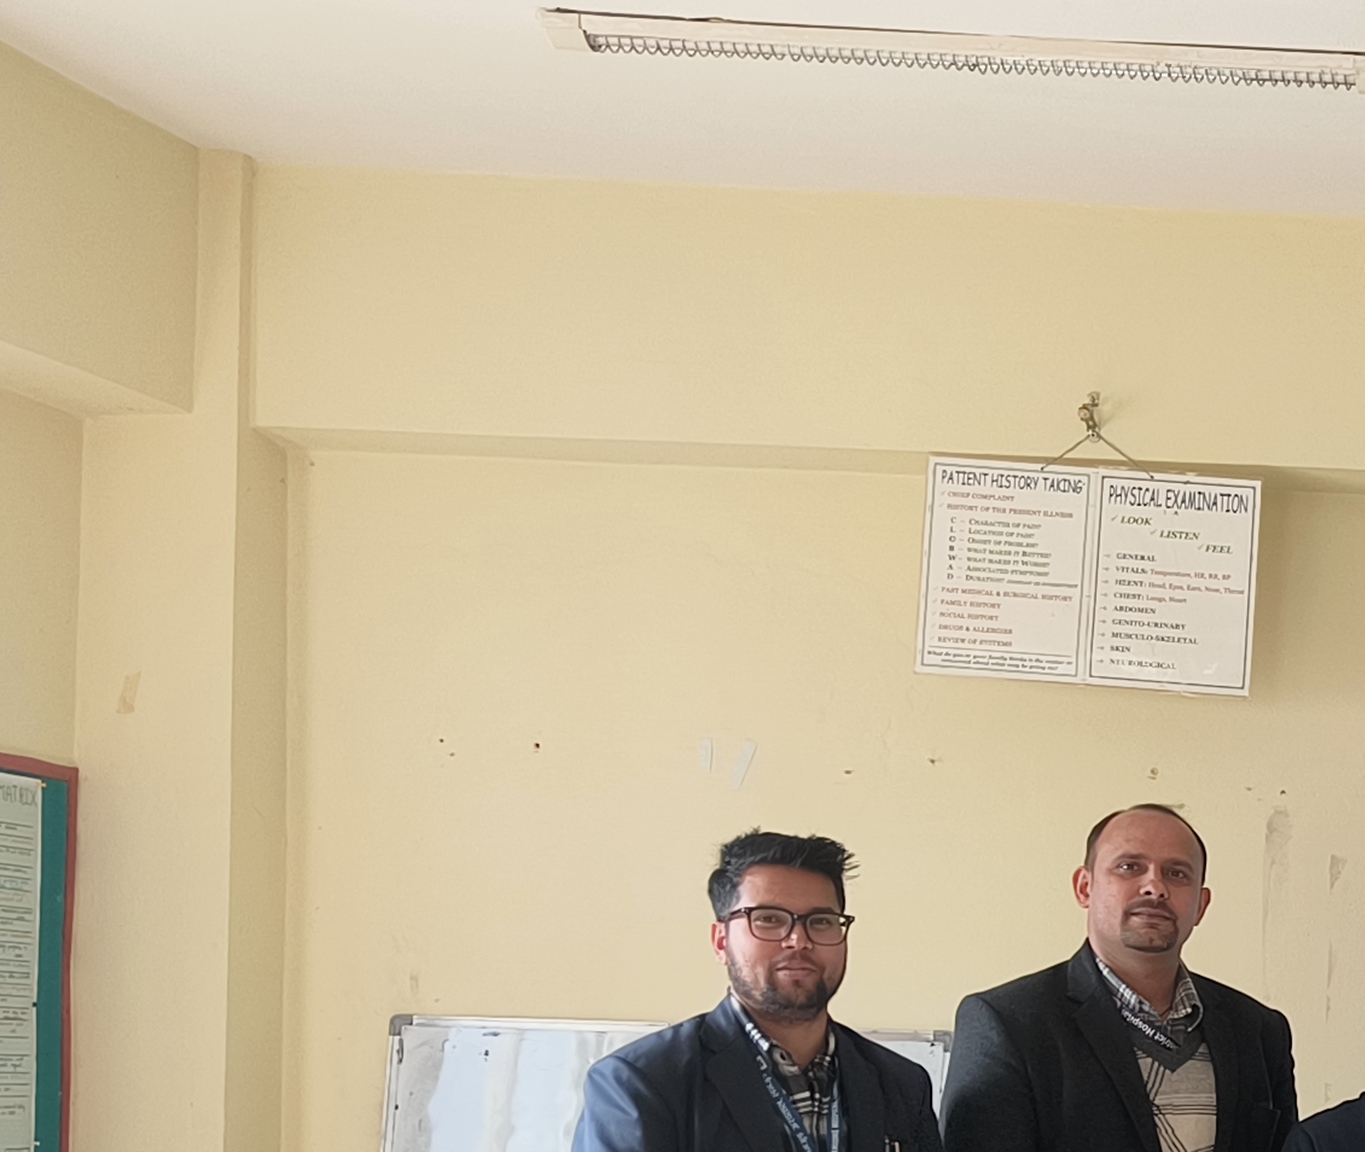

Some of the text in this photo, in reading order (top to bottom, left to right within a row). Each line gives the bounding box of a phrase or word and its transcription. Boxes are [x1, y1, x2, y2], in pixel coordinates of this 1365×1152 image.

[942, 470, 1084, 494] PATIENT HISTORY TAKING
[948, 491, 1015, 502] CHIEF COMPLAINT
[1108, 485, 1249, 514] PHYSICAL EXAMINATION
[947, 504, 978, 512] HISTORY
[992, 506, 1006, 514] THE
[1008, 508, 1041, 516] PRESENT
[1043, 510, 1074, 518] ILLNESS
[1120, 516, 1154, 526] LOOK
[1160, 530, 1200, 540] LISTEN
[1205, 544, 1234, 554] FEEL
[1116, 552, 1157, 562] GENERAL
[1116, 566, 1148, 575] VITALS:
[961, 588, 994, 596] MEDICAL
[1003, 591, 1039, 600] SURGICAL
[1042, 594, 1073, 602] HISTORY
[1114, 592, 1144, 601] CHEST:
[940, 598, 1001, 609] FAMILY HISTORY
[1112, 606, 1156, 614] ABDOMEN
[939, 612, 999, 622] SOCIAL HISTORY
[938, 624, 964, 632] DRUGS
[972, 626, 1012, 634] ALLERGIES
[1112, 618, 1186, 630] GENITO-URINARY
[938, 636, 966, 644] REVIEW
[979, 639, 1012, 647] SYSTEMS
[1111, 632, 1199, 645] MUSCULO-SKELETAL
[1110, 645, 1131, 653] SKIN
[1110, 658, 1176, 670] NEUROLOGICAL
